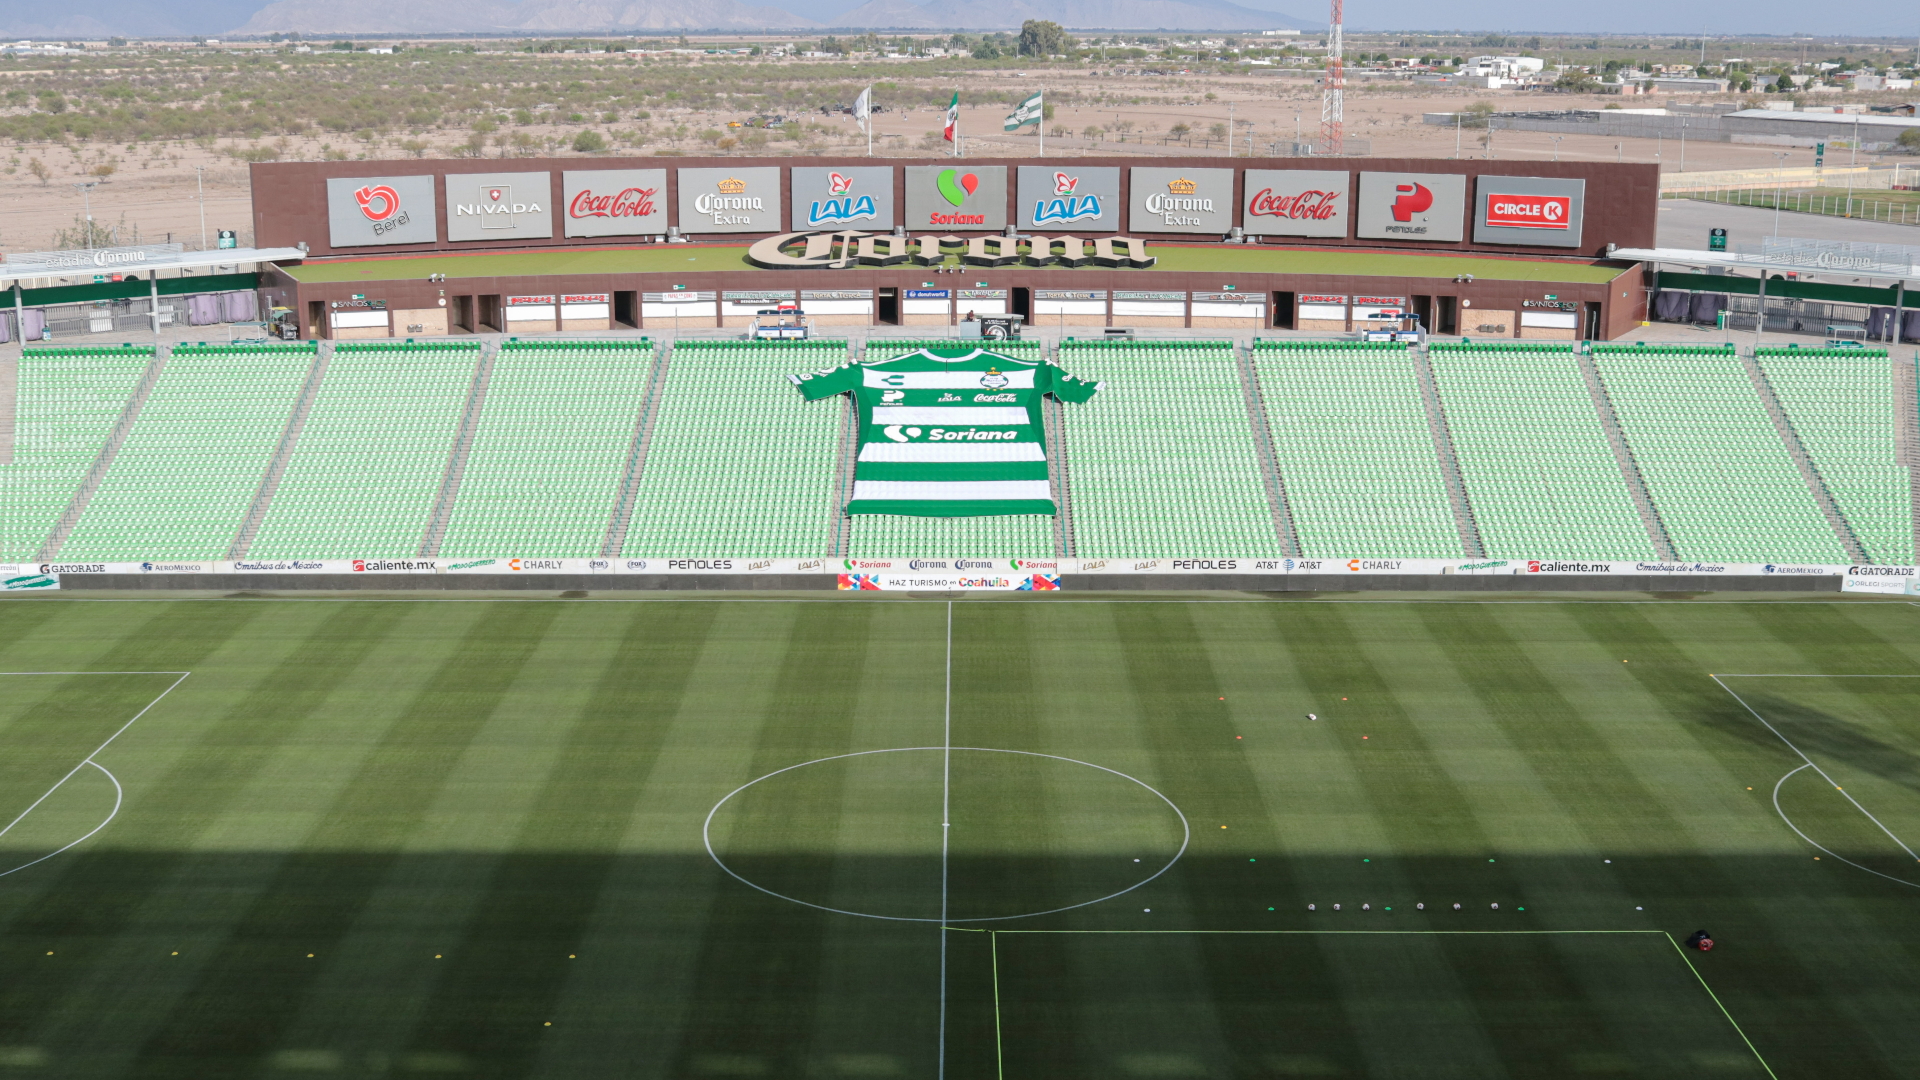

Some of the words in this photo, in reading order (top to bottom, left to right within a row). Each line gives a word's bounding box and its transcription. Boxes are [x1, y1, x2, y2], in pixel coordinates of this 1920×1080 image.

[569, 187, 659, 219] Coca-Cola
[694, 192, 763, 216] Corona
[1145, 192, 1214, 216] Corona
[1249, 187, 1342, 220] Coca-Cola
[456, 202, 543, 217] NIVADA
[1493, 202, 1541, 217] CIRCLE
[373, 210, 411, 237] Berel
[713, 211, 751, 226] Extra
[929, 211, 985, 225] Soriana
[1164, 211, 1201, 226] Extra
[747, 229, 1156, 269] Corona
[45, 253, 92, 268] estadio
[93, 249, 146, 268] Corona
[1817, 251, 1873, 268] Corona
[973, 393, 1017, 403] Coca-Cola
[928, 428, 1017, 441] Soriana
[51, 564, 106, 573] GATORADE
[234, 560, 274, 571] Omnibus
[274, 560, 287, 570] de
[365, 560, 436, 572] caliente.mx
[523, 560, 563, 570] CHARLY
[668, 559, 733, 570] PEÑOLES
[859, 560, 892, 569] Soriana
[909, 559, 947, 571] Corona
[954, 559, 993, 571] Corona
[1025, 560, 1058, 570] Soriana
[1172, 558, 1237, 570] PEÑOLES
[1255, 561, 1279, 570] AT&T
[1298, 561, 1322, 570] AT&T
[1362, 561, 1402, 570] CHARLY
[1539, 561, 1611, 573] caliente.mx
[1636, 562, 1675, 572] Omnibus
[1676, 563, 1689, 572] de
[1860, 567, 1915, 576] GATORADE
[888, 579, 907, 587] HAZ
[909, 579, 948, 587] TURISMO
[958, 577, 1010, 588] Coahuila
